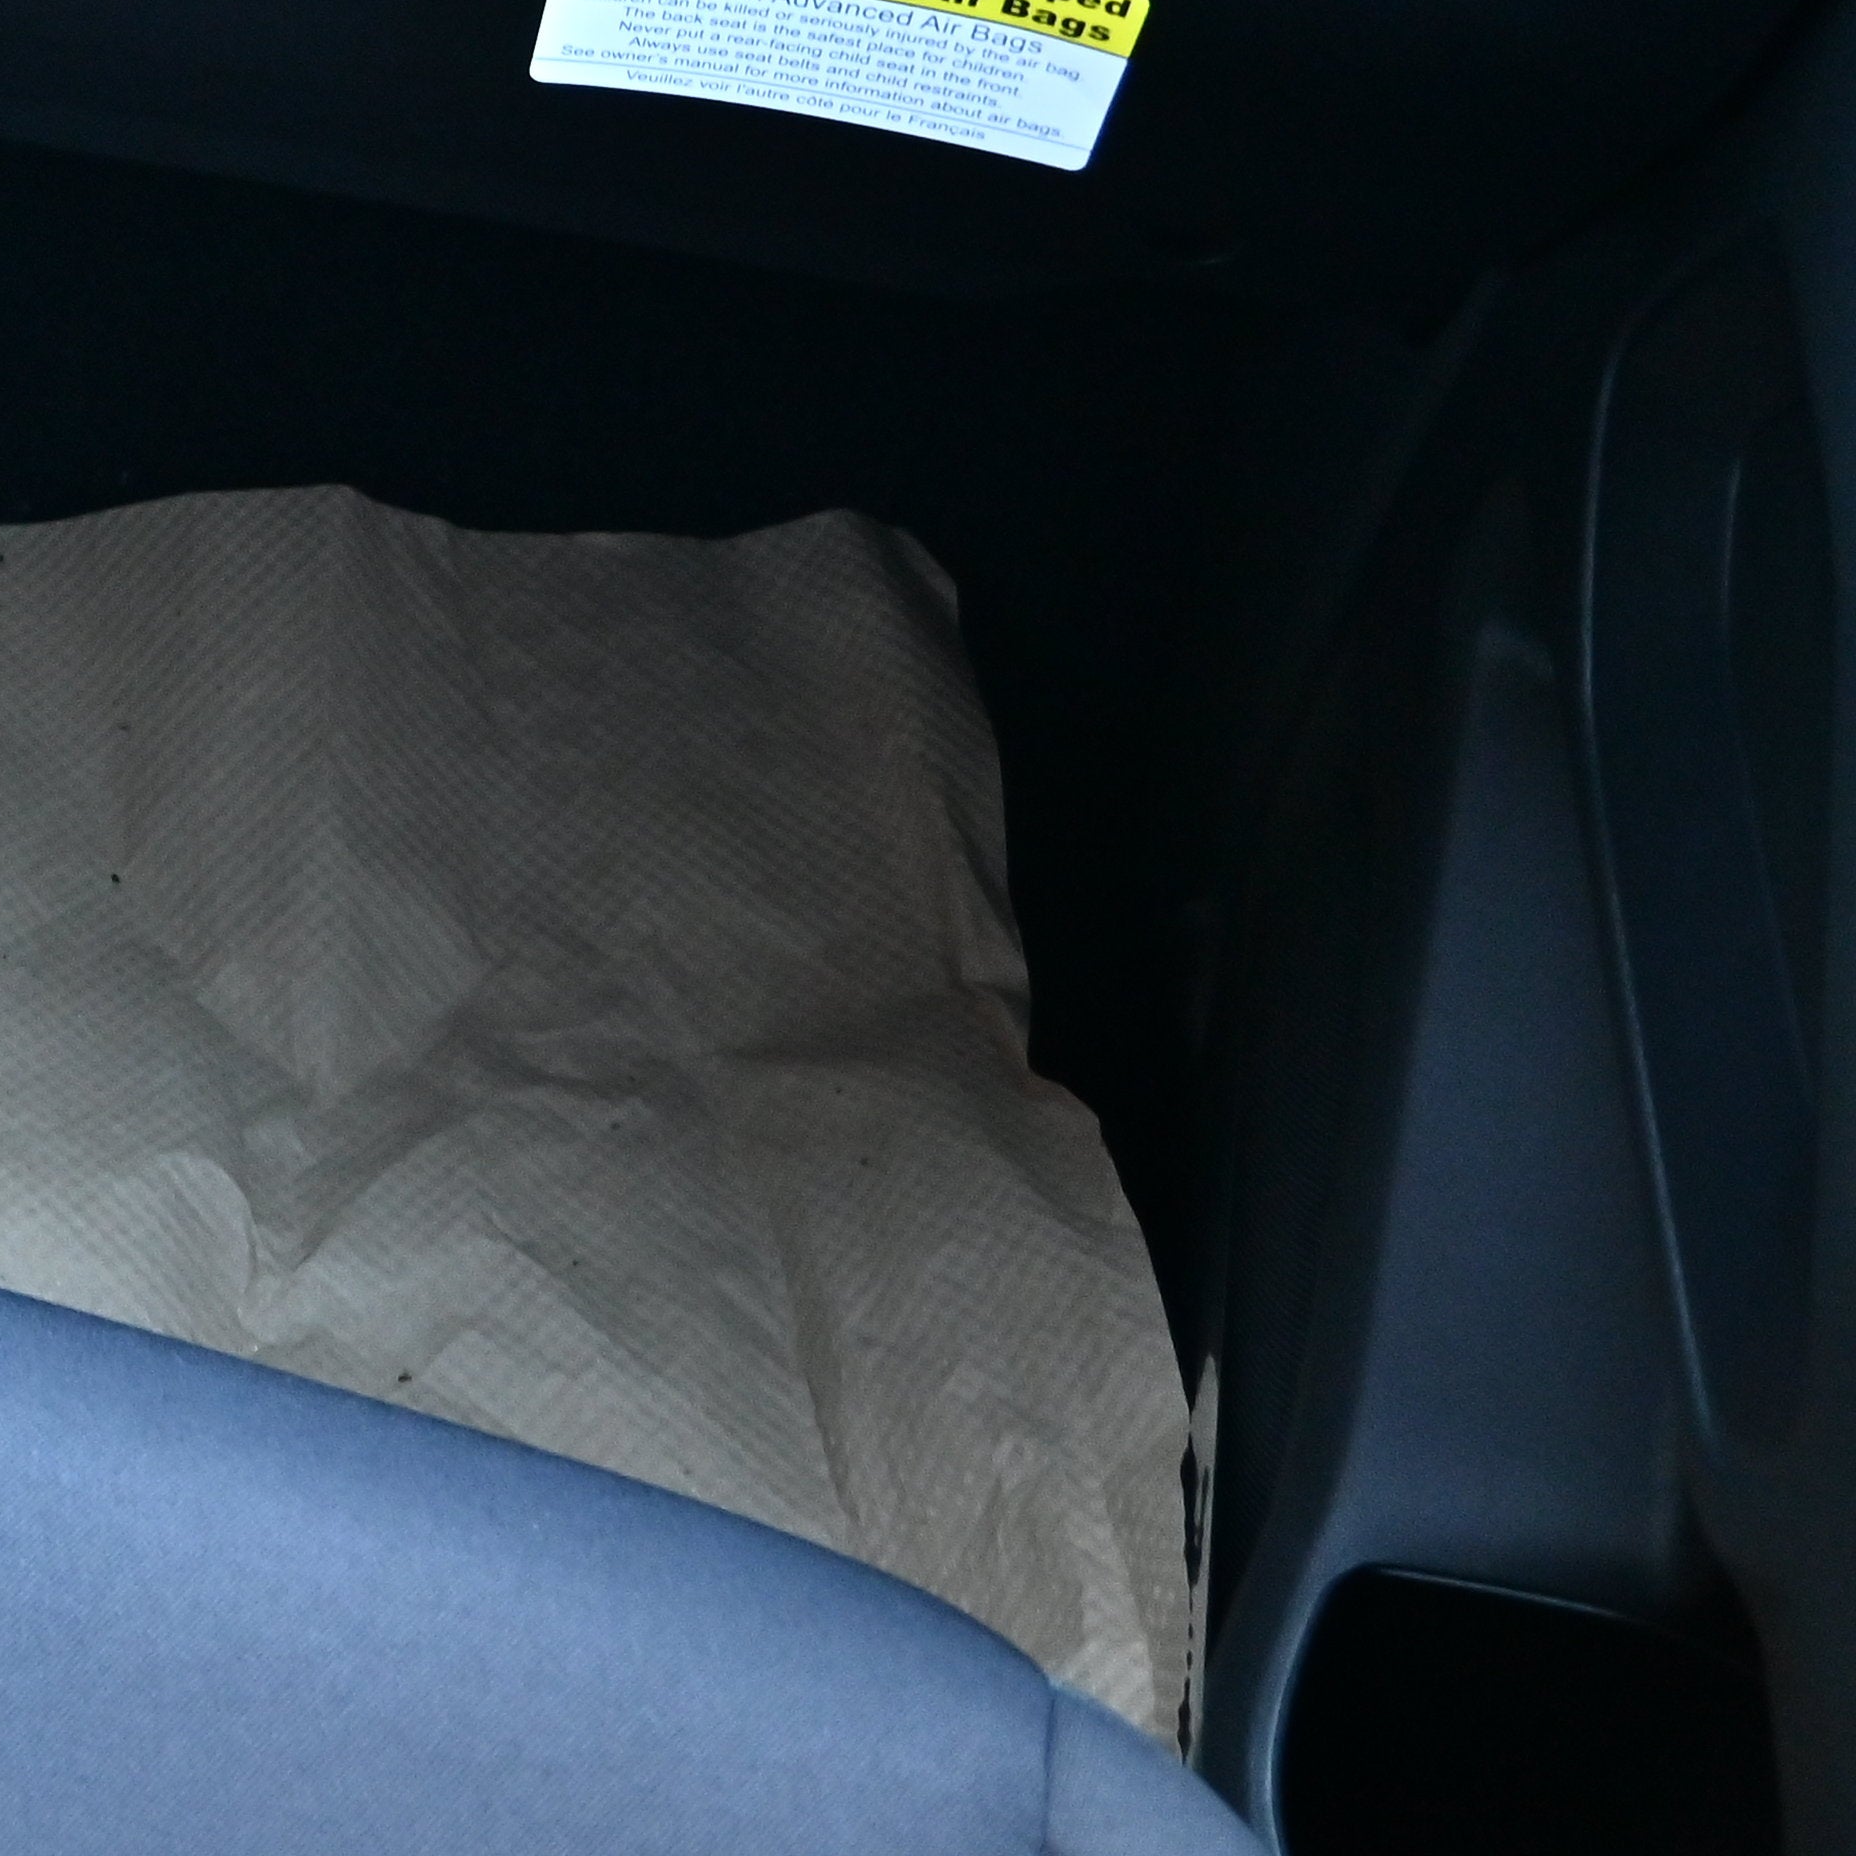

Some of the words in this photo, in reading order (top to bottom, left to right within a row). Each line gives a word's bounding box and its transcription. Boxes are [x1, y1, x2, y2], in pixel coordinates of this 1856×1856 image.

[619, 19, 672, 36] Never
[676, 27, 705, 40] put
[727, 33, 823, 59] rear-facing
[828, 48, 872, 66] child
[876, 58, 916, 75] seat
[920, 66, 937, 78] in
[942, 70, 972, 86] the
[623, 5, 656, 20] The
[661, 9, 703, 25] back
[709, 16, 747, 30] seat
[753, 20, 767, 33] is
[773, 24, 801, 38] the
[806, 30, 862, 48] safest
[866, 39, 916, 59] place
[922, 50, 945, 65] for
[629, 35, 691, 54] Always
[697, 43, 729, 58] use
[734, 50, 773, 64] seat
[778, 55, 821, 72] belts
[826, 65, 861, 80] and
[865, 71, 909, 89] child
[723, 1, 771, 18] killed
[775, 10, 793, 21] or
[799, 13, 880, 38] seriously
[885, 28, 948, 50] injured
[953, 41, 975, 58] by
[981, 48, 1010, 63] the
[1015, 57, 1040, 69] air
[920, 15, 962, 36] Air
[970, 23, 1043, 54] Bags
[560, 44, 596, 58] See
[601, 49, 668, 65] owner's
[673, 56, 739, 74] manual
[745, 64, 767, 78] for
[773, 70, 819, 87] more
[824, 78, 925, 107] information
[930, 97, 983, 120] about
[987, 110, 1012, 125] air
[626, 68, 693, 88] Veuillez
[699, 79, 730, 93] voir
[796, 95, 835, 111] côté
[839, 102, 881, 119] pour
[886, 109, 902, 123] le
[907, 113, 986, 142] Français
